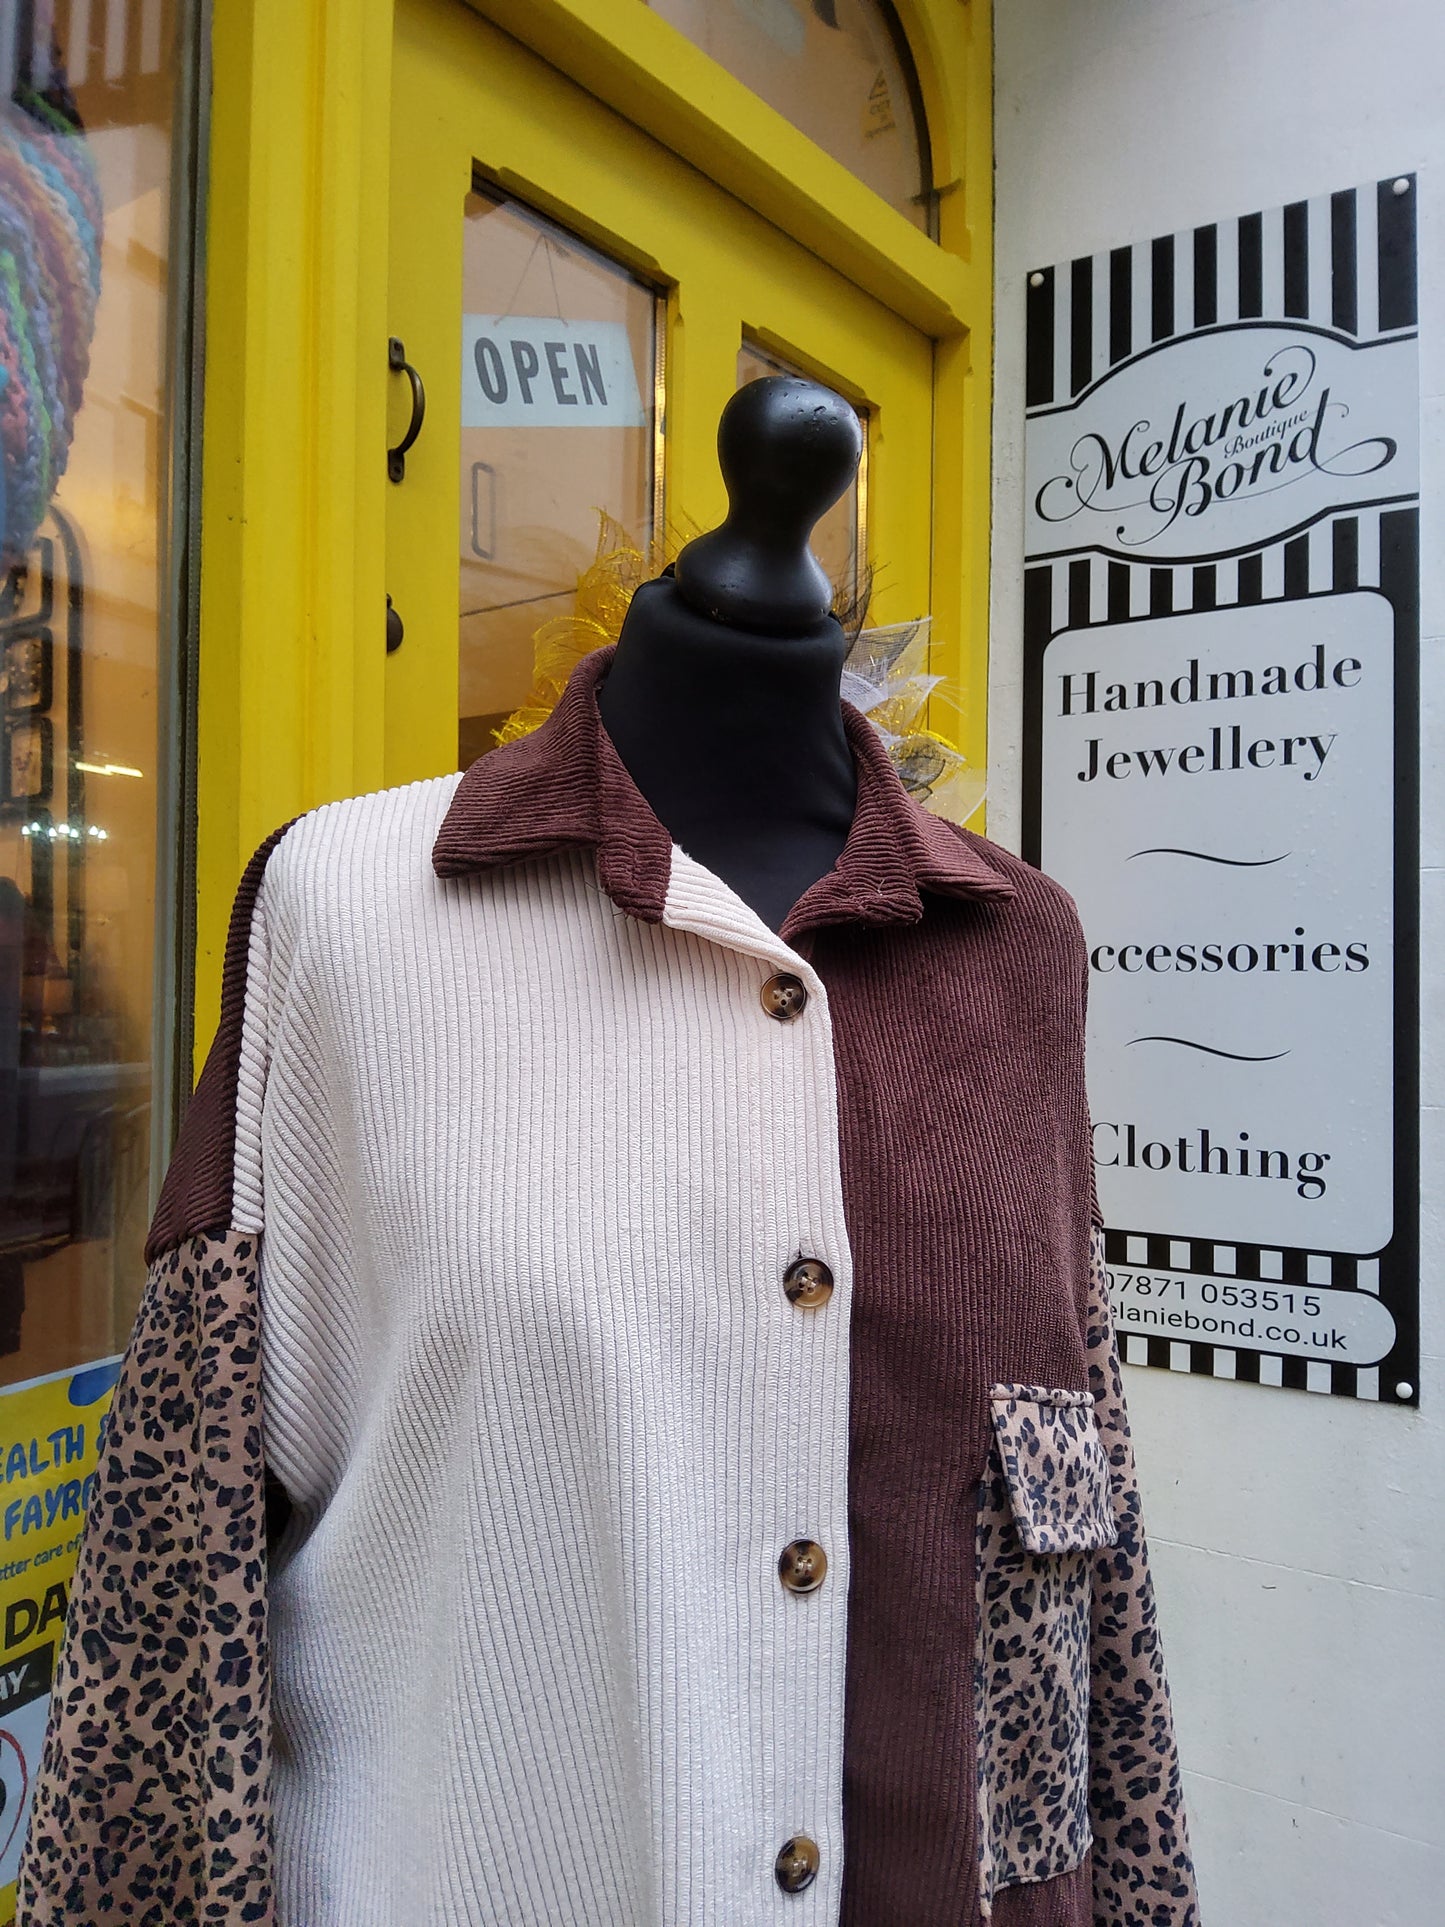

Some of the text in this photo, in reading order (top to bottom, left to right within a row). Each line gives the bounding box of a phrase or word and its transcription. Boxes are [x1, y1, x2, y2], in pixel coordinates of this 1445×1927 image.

[474, 337, 608, 406] OPEN
[1036, 345, 1316, 521] Melanie
[1224, 409, 1308, 459] Boutique
[1116, 387, 1397, 545] Bond
[1057, 643, 1363, 717] Handmade
[1077, 725, 1338, 782] Jewellery
[1090, 926, 1370, 973] ccessories
[1091, 1121, 1331, 1200] Clothing
[1110, 1301, 1348, 1350] elaniebond.co.uk
[1200, 1283, 1322, 1317] 053515
[0, 1423, 85, 1484] ALTH
[34, 1544, 63, 1567] care
